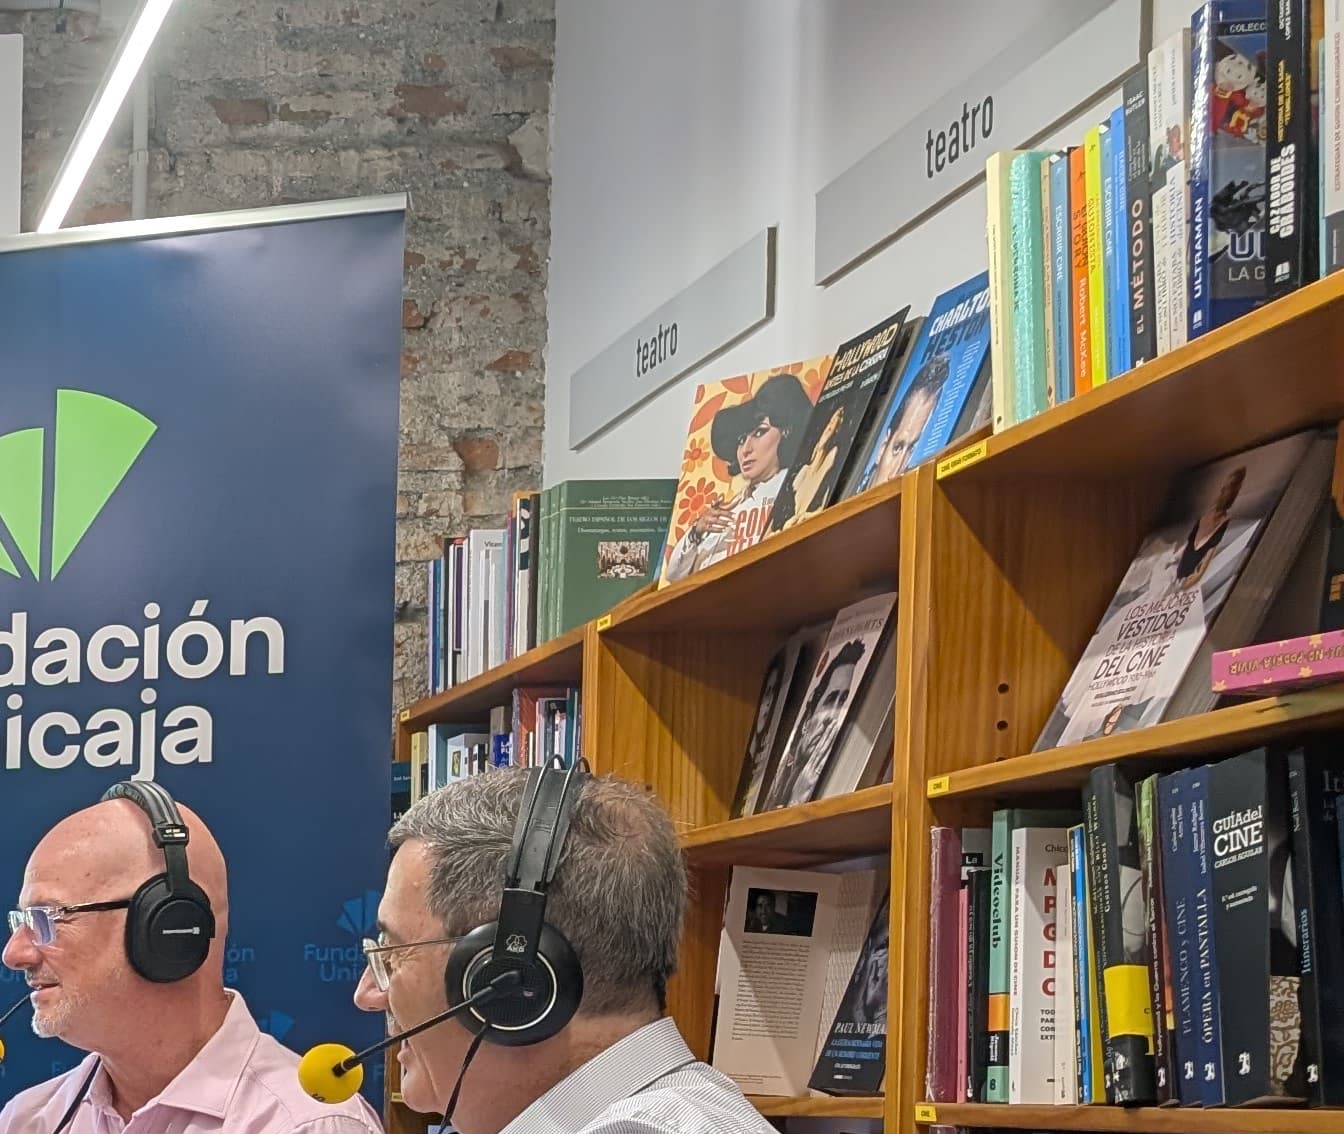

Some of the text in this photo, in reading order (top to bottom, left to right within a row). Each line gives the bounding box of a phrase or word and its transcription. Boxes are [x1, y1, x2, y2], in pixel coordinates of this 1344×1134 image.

[926, 95, 994, 178] teatro
[1269, 157, 1281, 234] CAZADOR DE
[1130, 199, 1145, 334] EL MÉTODO
[1193, 196, 1204, 300] ULTRAMAN
[636, 322, 678, 377] teatro
[833, 319, 896, 374] HOLLYWOOD
[1078, 278, 1088, 378] Robert McKee
[1117, 606, 1190, 641] VESTIDOS
[1125, 589, 1199, 620] LOS MEJORES
[1093, 645, 1171, 681] DEL CINE
[1212, 826, 1263, 857] CINE
[991, 854, 1004, 949] Videoclub
[1013, 914, 1020, 928] UN
[1176, 898, 1188, 935] CINE
[1013, 962, 1020, 973] DE
[1195, 888, 1215, 1044] ÓPERA en PANTALLA
[1299, 908, 1312, 974] Itinerarios
[1179, 949, 1192, 1034] FLAMENCO
